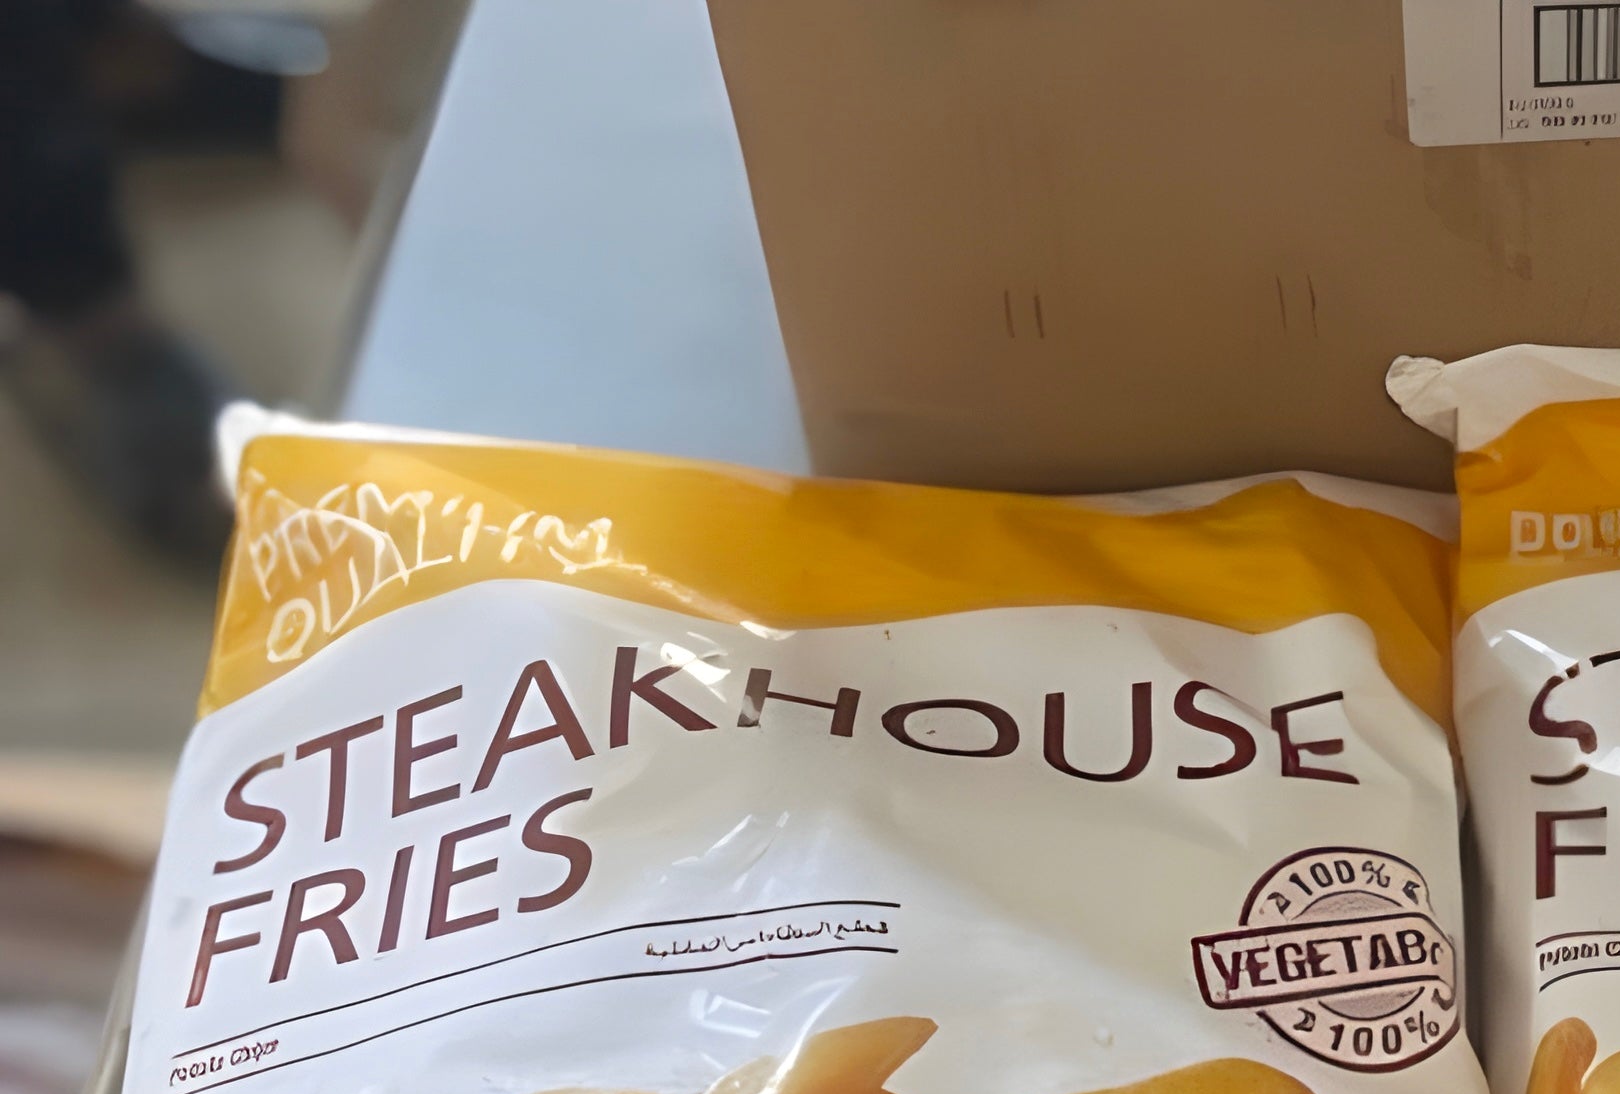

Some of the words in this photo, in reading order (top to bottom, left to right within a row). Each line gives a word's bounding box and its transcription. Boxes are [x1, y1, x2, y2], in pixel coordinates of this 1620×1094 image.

[213, 646, 1361, 875] STEAKHOUSE
[184, 787, 594, 1009] FRIES
[1288, 859, 1391, 896] 100%
[1330, 1009, 1441, 1056] 100%
